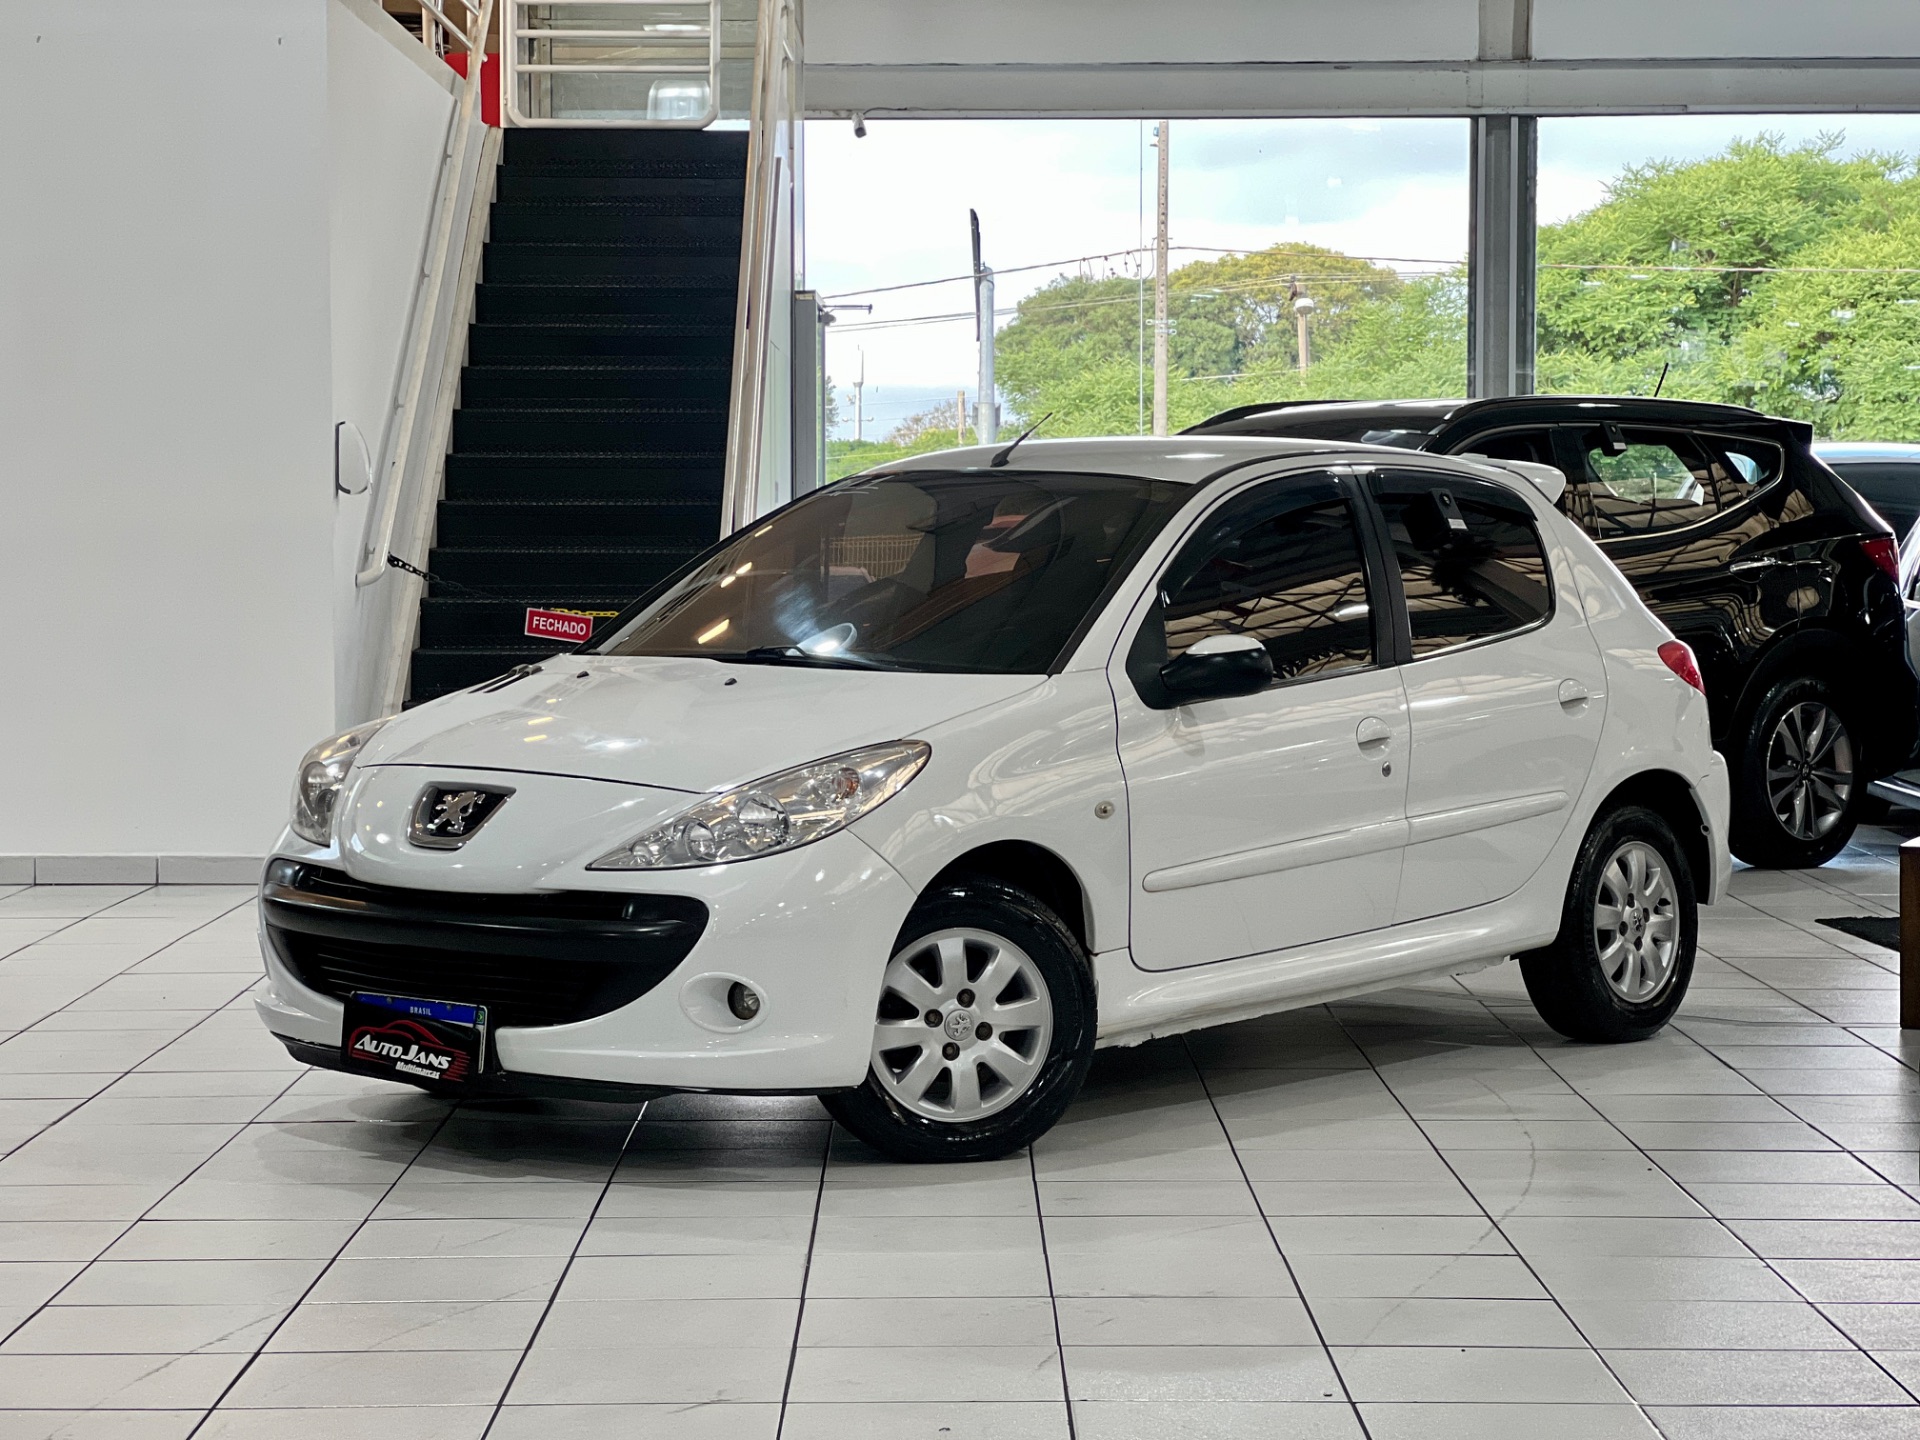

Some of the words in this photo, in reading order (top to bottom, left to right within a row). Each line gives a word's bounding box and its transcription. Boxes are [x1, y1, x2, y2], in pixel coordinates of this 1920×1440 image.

[532, 616, 587, 636] FECHADO
[409, 1006, 432, 1016] BRASIL
[395, 1061, 440, 1079] Multimarcas
